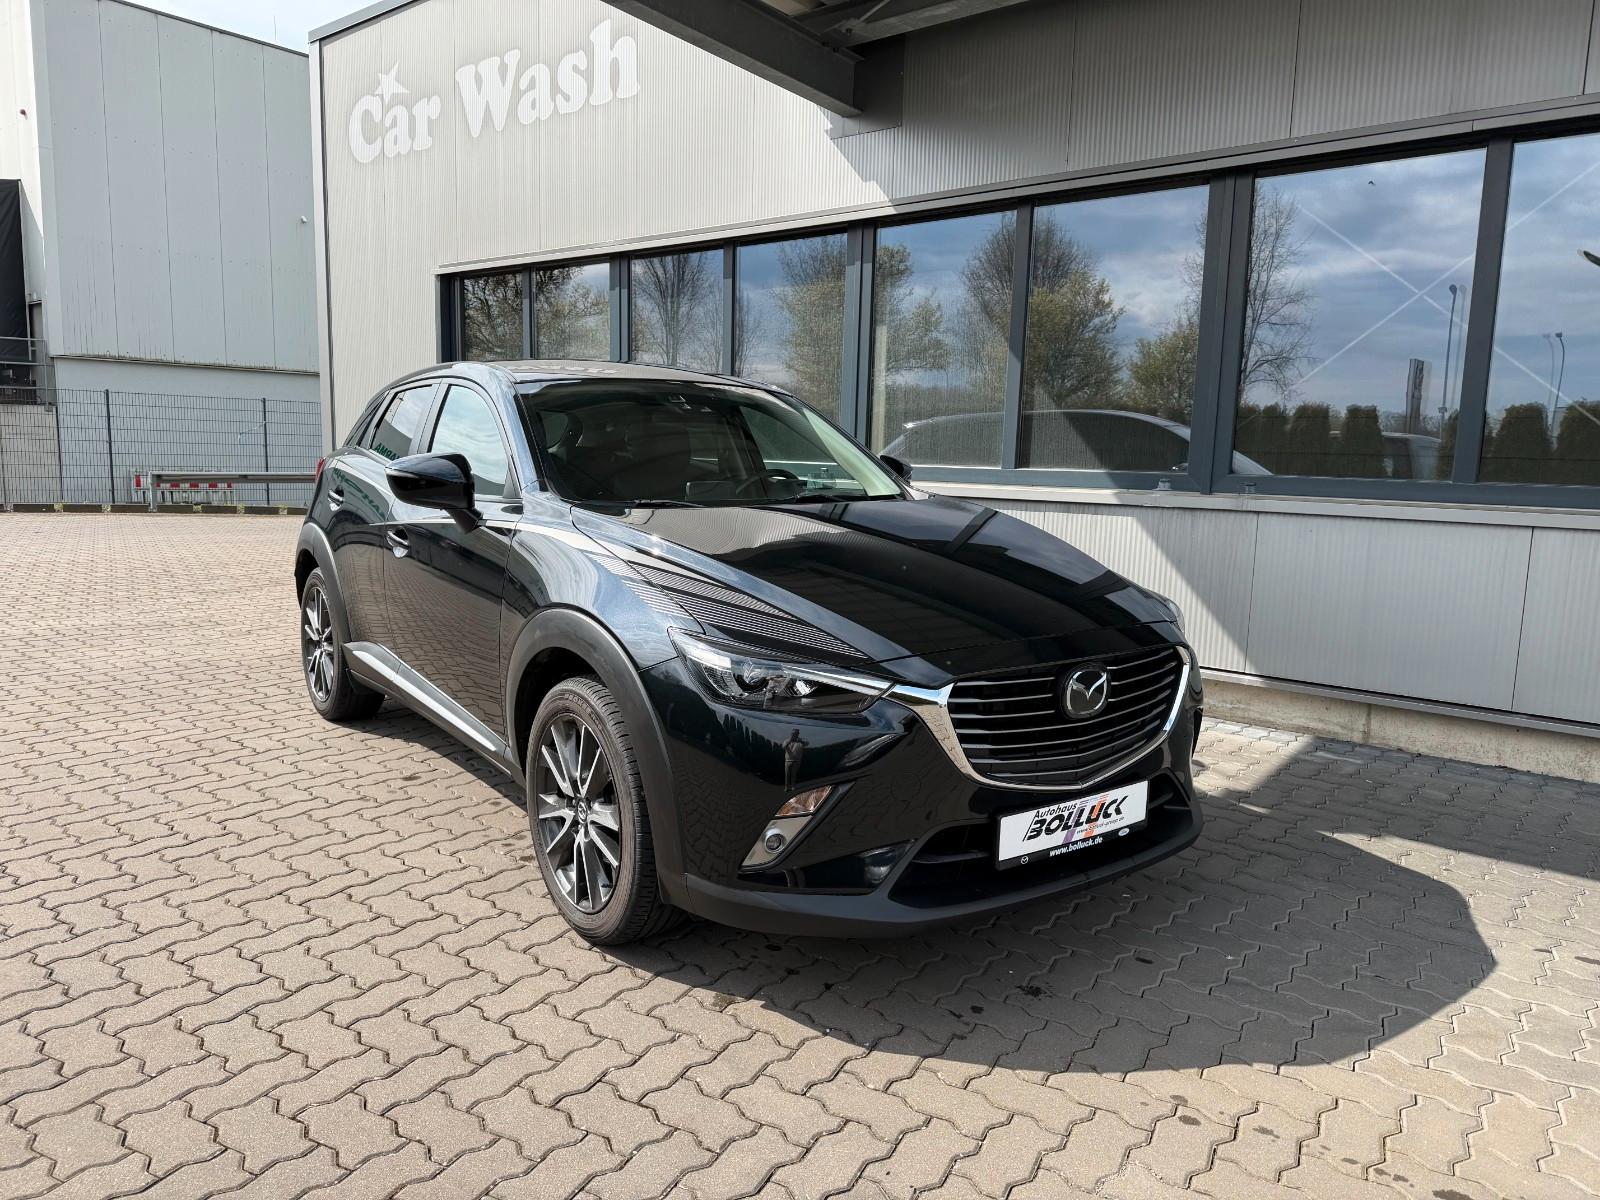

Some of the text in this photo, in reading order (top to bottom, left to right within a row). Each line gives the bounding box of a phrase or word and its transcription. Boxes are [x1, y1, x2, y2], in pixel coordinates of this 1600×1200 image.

[348, 18, 641, 164] Car Wash
[1024, 795, 1129, 842] BOLLUCK
[1034, 802, 1078, 820] Autohaus
[1049, 835, 1104, 857] www.bolluck.de
